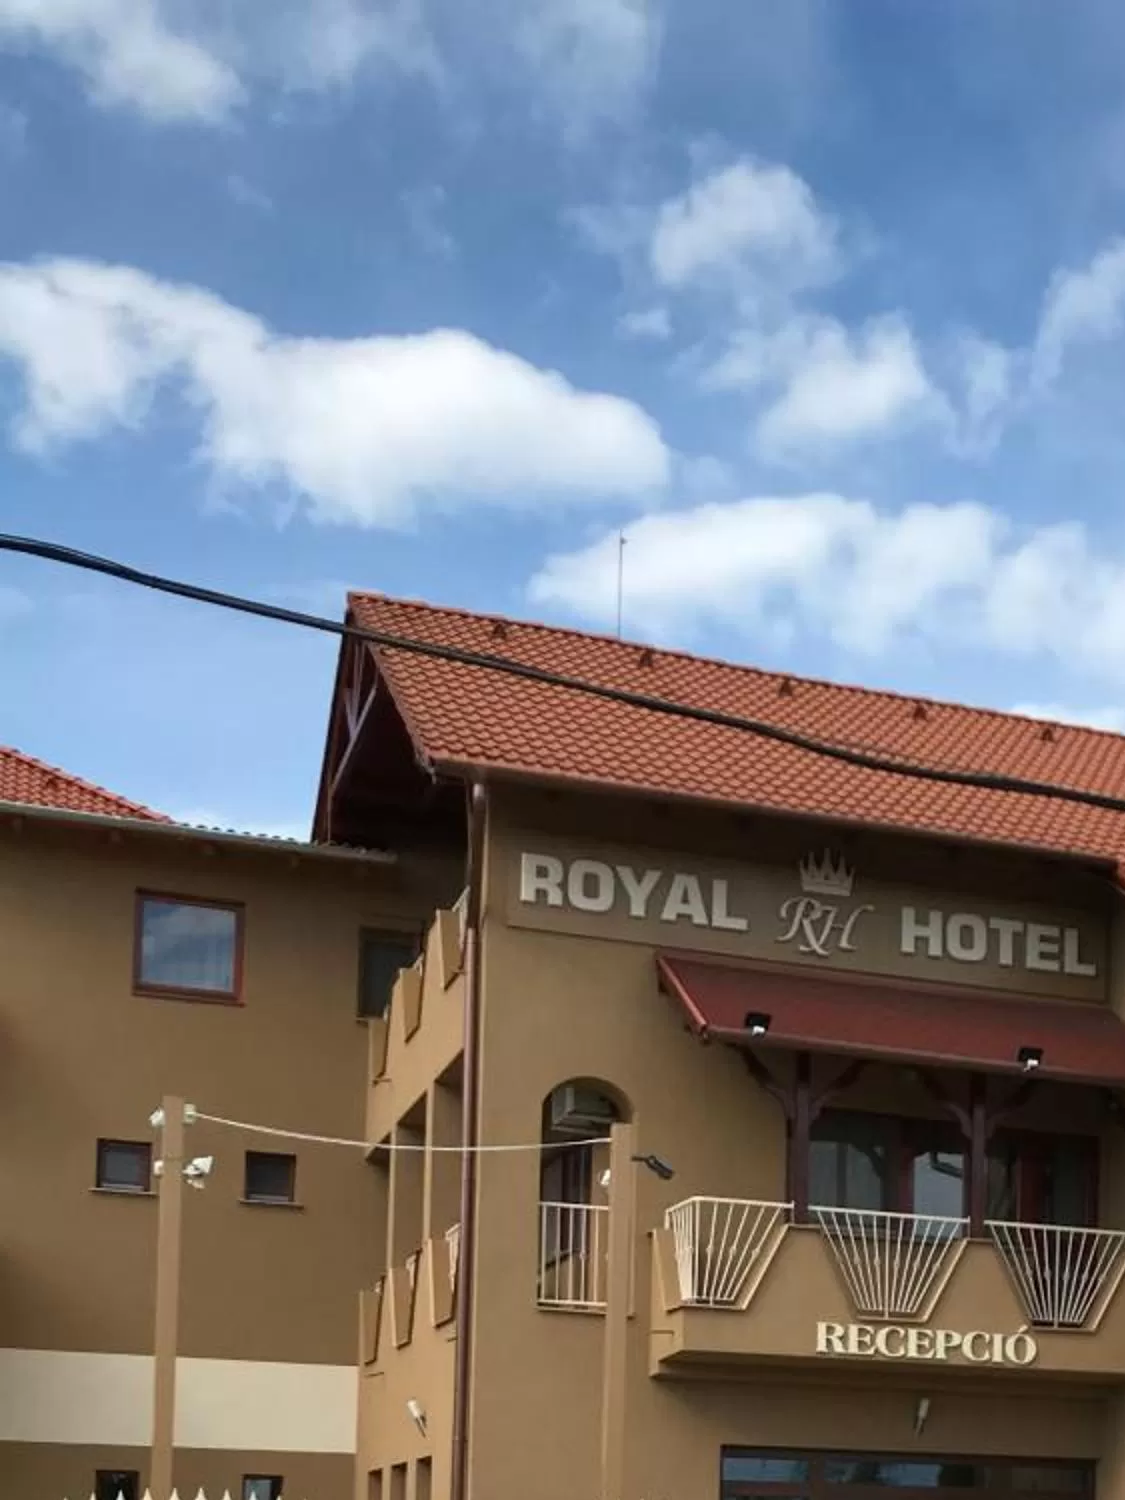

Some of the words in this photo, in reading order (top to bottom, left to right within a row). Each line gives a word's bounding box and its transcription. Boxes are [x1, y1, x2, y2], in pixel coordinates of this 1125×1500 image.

[520, 853, 748, 931] ROYAL
[777, 896, 875, 955] RH
[901, 907, 1096, 976] HOTEL
[816, 1321, 1037, 1365] RECEPCIÓ
